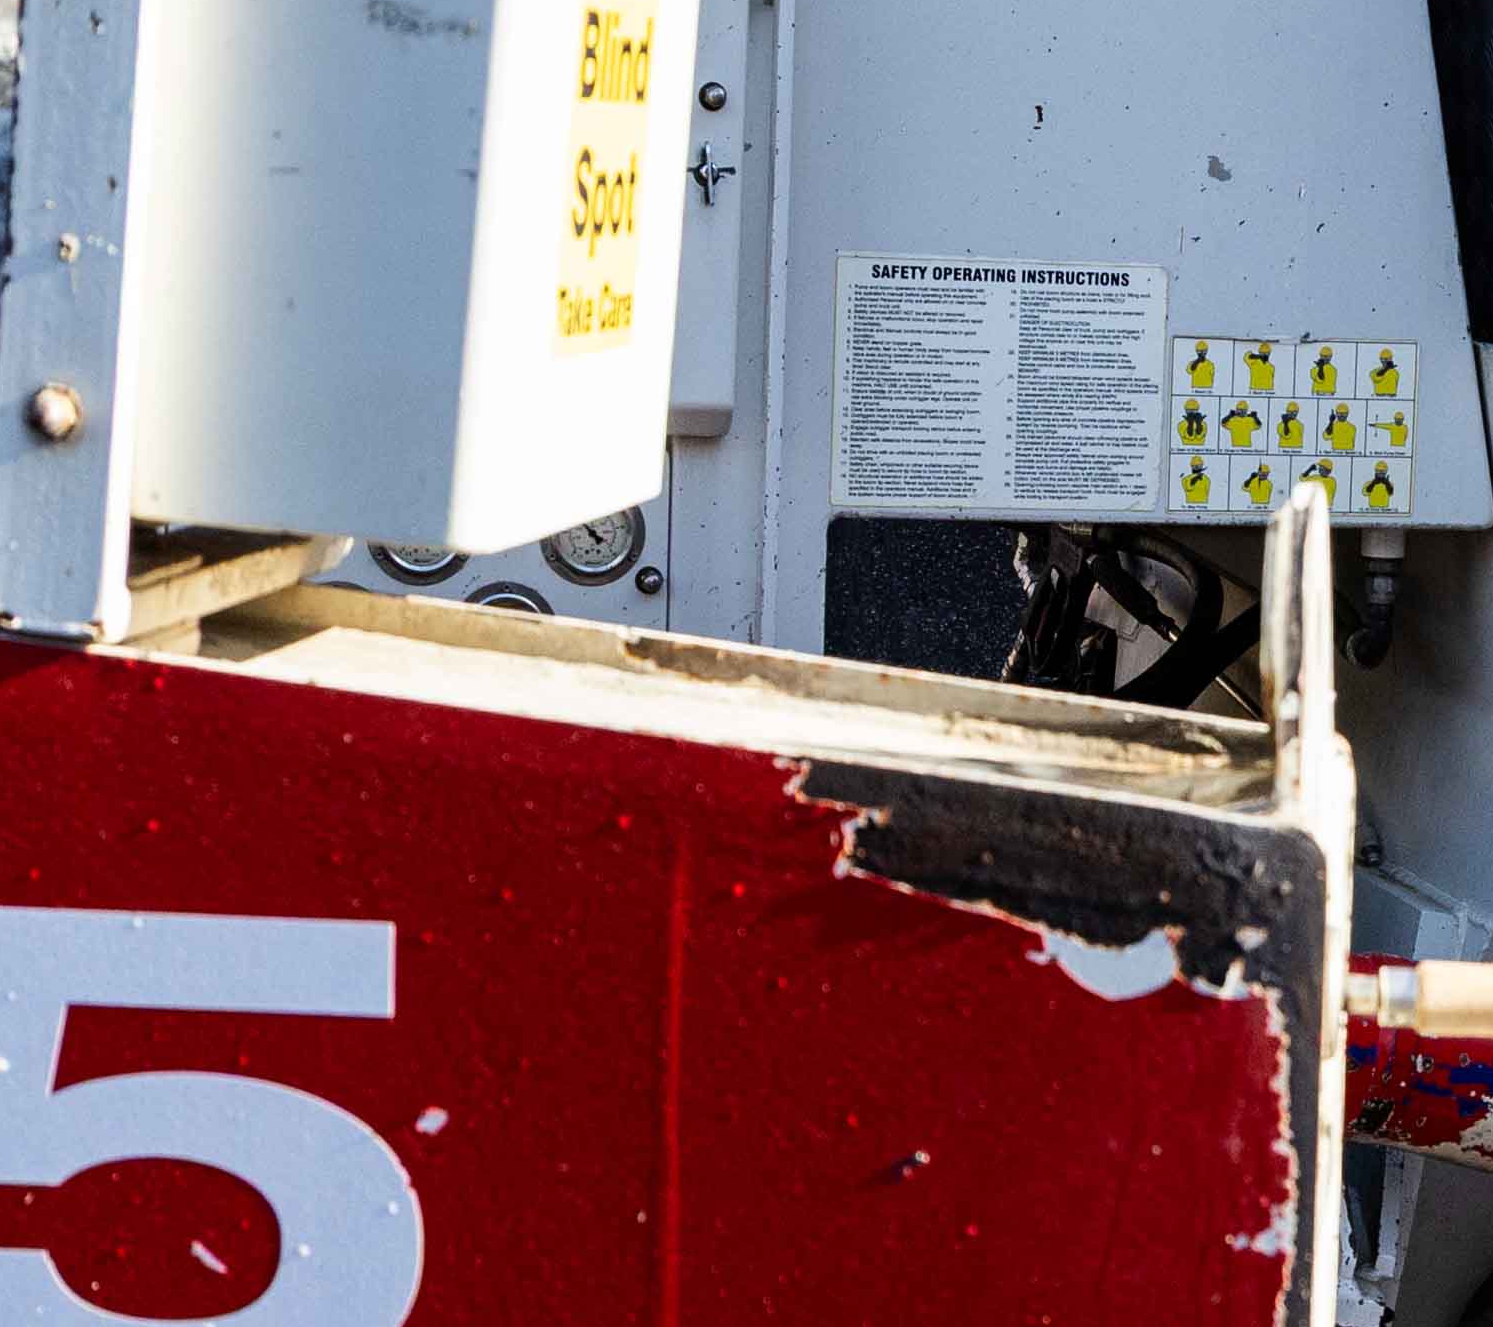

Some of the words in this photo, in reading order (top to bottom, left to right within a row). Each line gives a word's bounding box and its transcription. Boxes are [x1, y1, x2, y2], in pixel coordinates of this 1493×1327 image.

[581, 8, 654, 103] Blind
[572, 146, 637, 259] Spot
[558, 285, 593, 337] Take
[598, 281, 634, 330] Care
[872, 265, 928, 280] SAFETY
[932, 266, 1016, 283] OPERATING
[1021, 269, 1130, 287] INSTRUCTIONS
